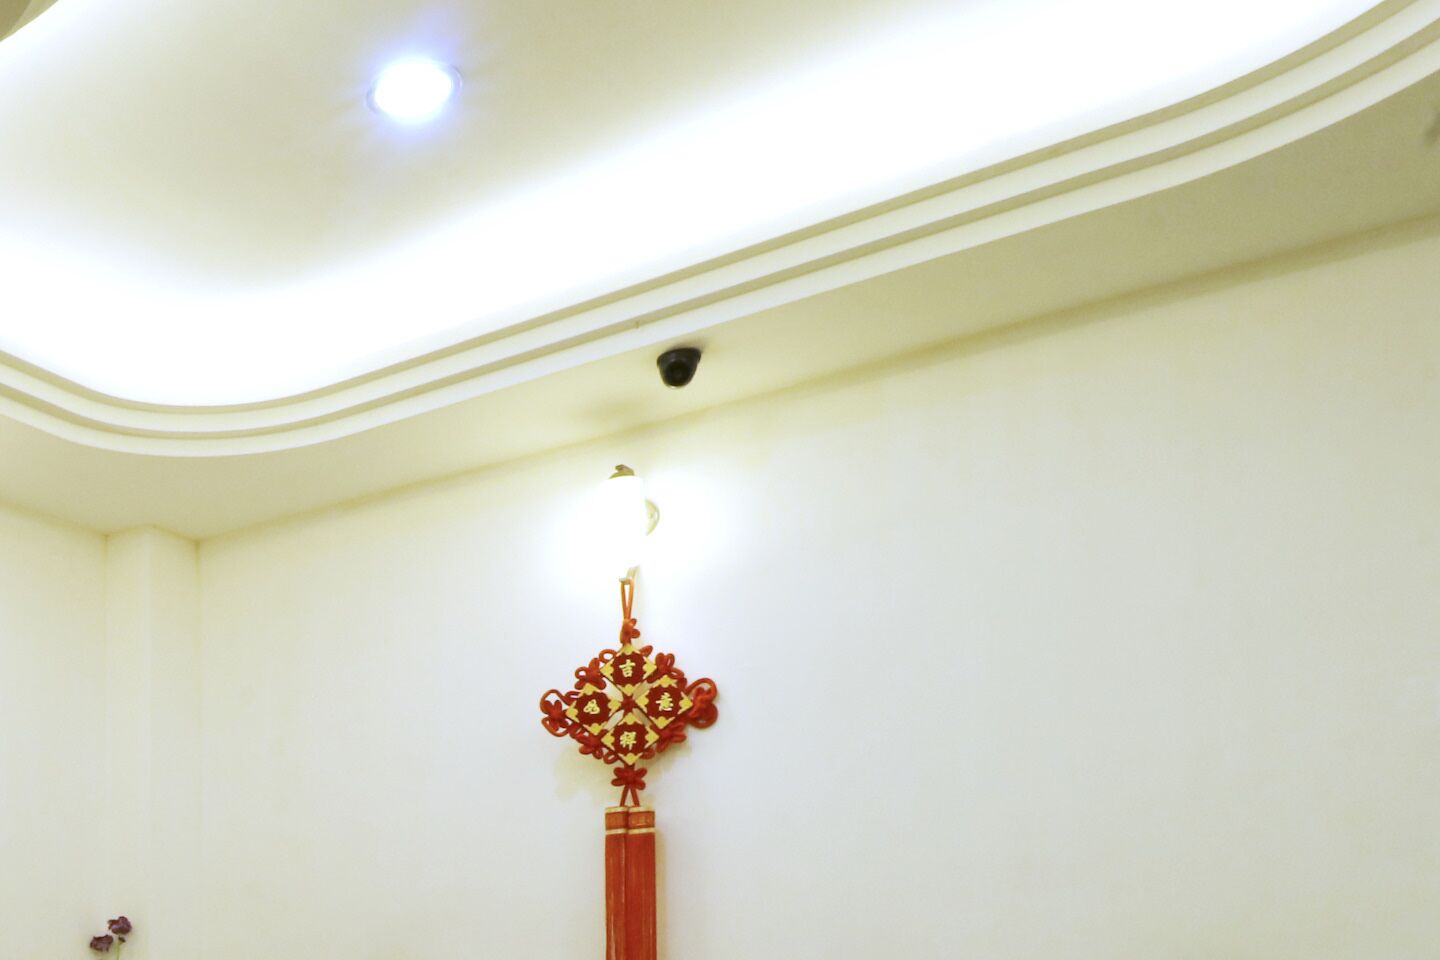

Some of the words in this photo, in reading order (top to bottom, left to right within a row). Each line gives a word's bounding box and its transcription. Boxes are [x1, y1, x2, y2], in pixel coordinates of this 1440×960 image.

[619, 659, 636, 678] 吉
[655, 692, 674, 712] 意
[619, 731, 637, 750] 祥
